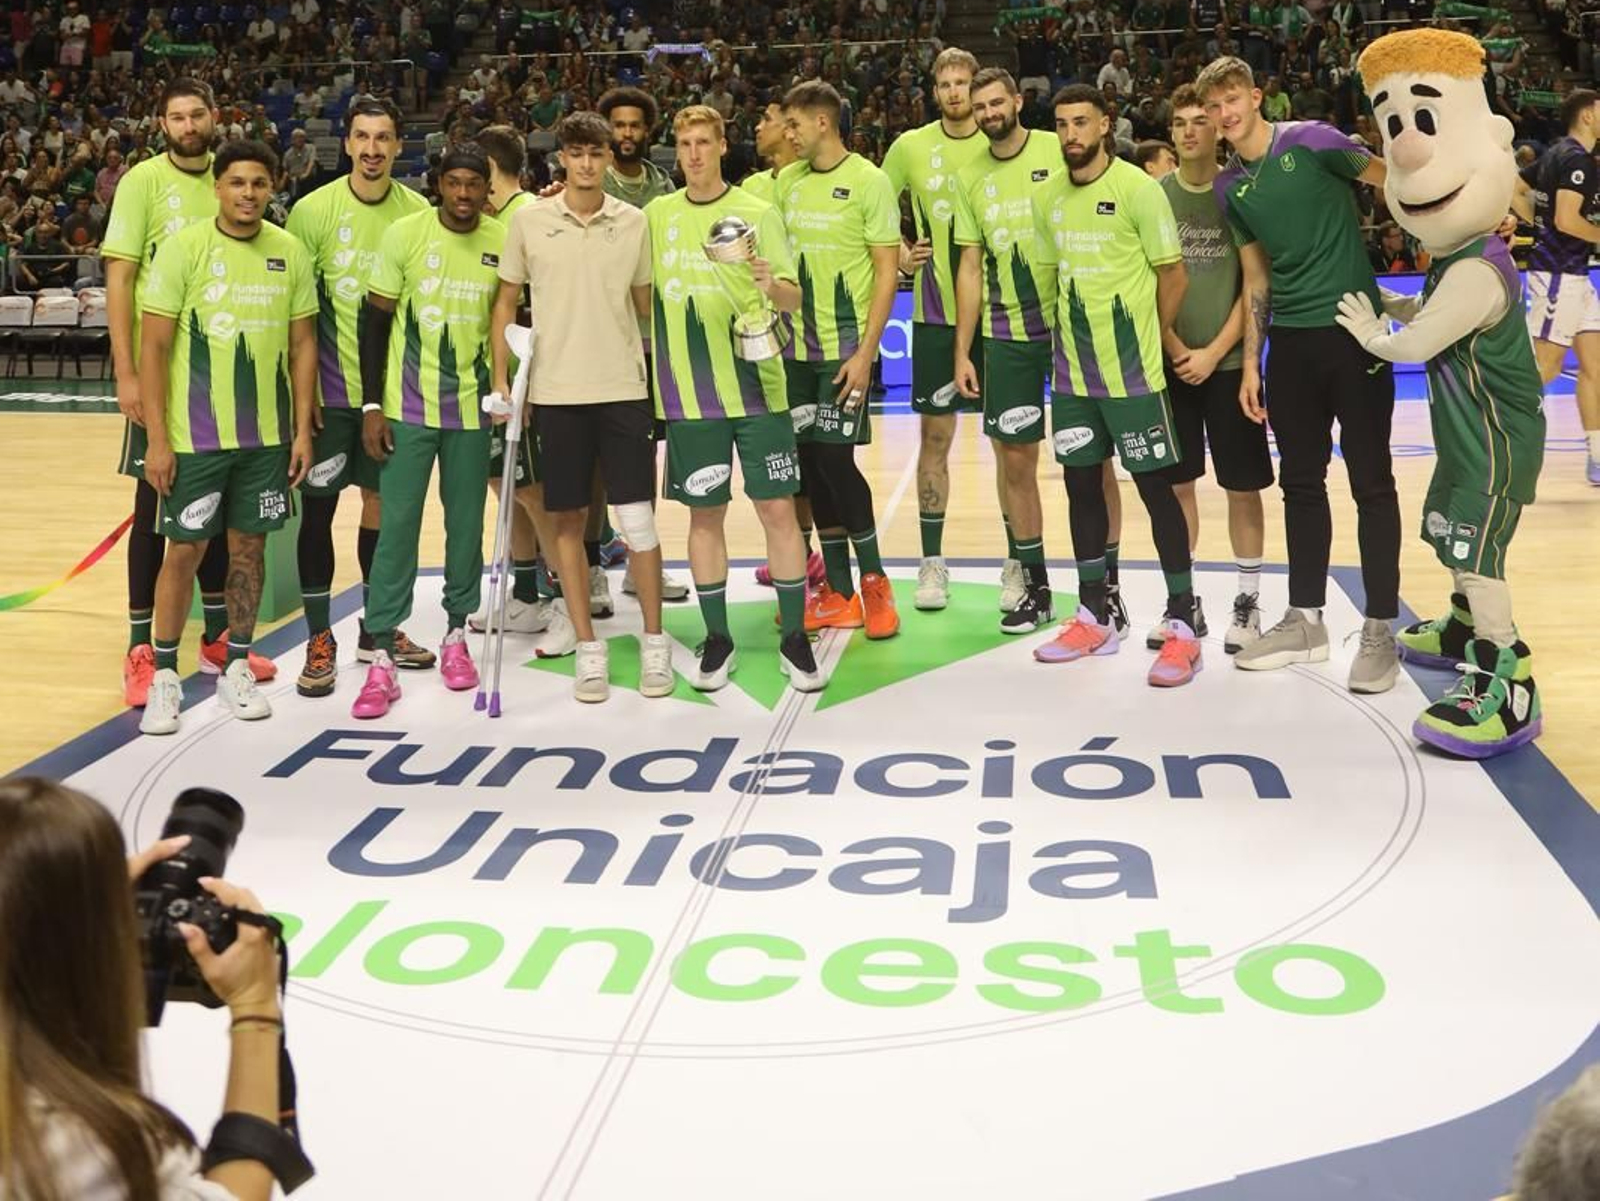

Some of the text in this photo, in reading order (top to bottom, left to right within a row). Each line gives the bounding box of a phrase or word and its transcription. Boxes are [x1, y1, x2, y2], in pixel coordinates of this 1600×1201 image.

[767, 466, 795, 481] laga
[771, 451, 792, 469] má
[263, 729, 1292, 800] Fundación
[326, 806, 1159, 924] Unicaja
